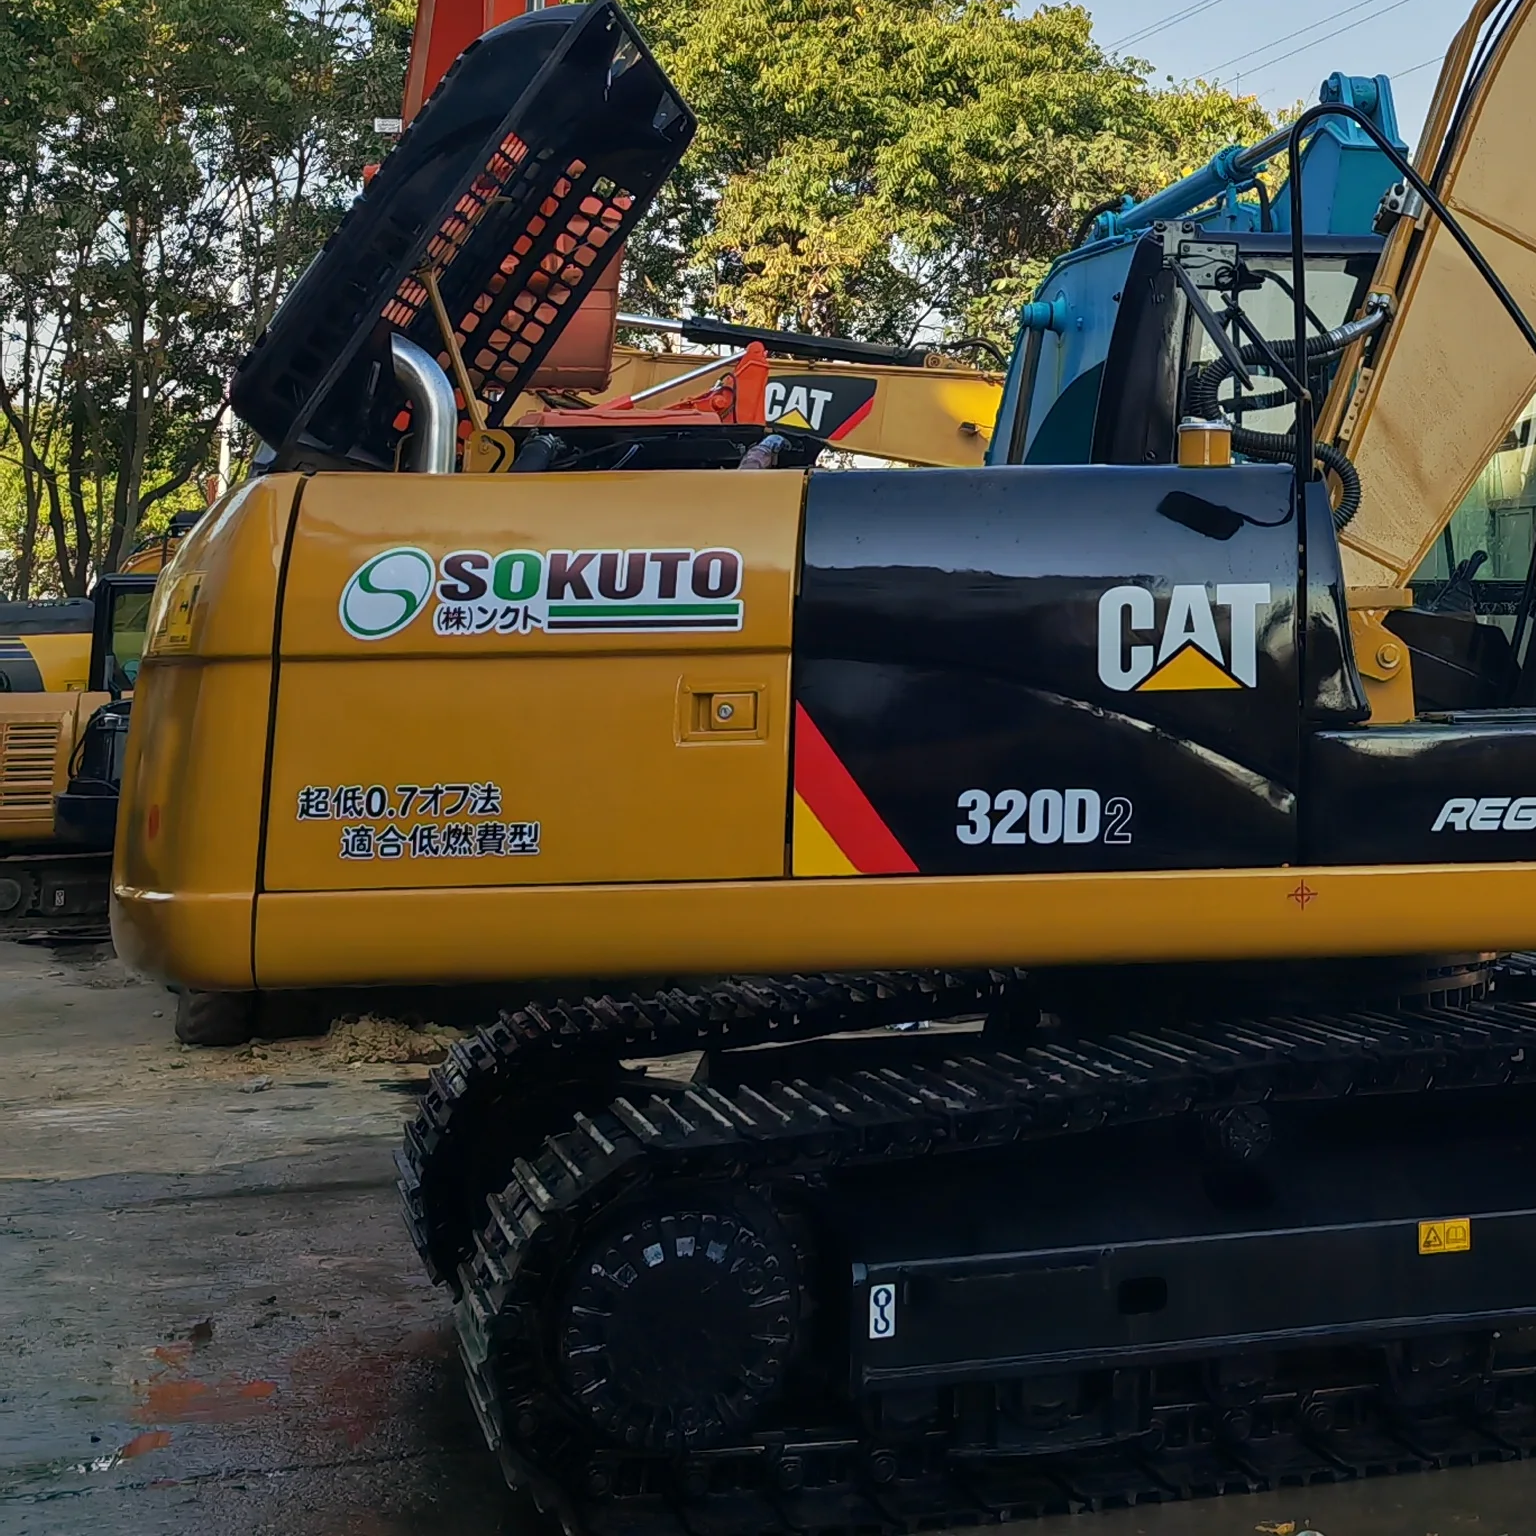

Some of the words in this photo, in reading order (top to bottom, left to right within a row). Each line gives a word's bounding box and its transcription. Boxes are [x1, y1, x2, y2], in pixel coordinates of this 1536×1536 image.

[764, 382, 833, 430] CAT
[439, 550, 740, 600] SOKUTO
[1098, 582, 1271, 692] CAT
[340, 822, 539, 858] 適合低燃費型
